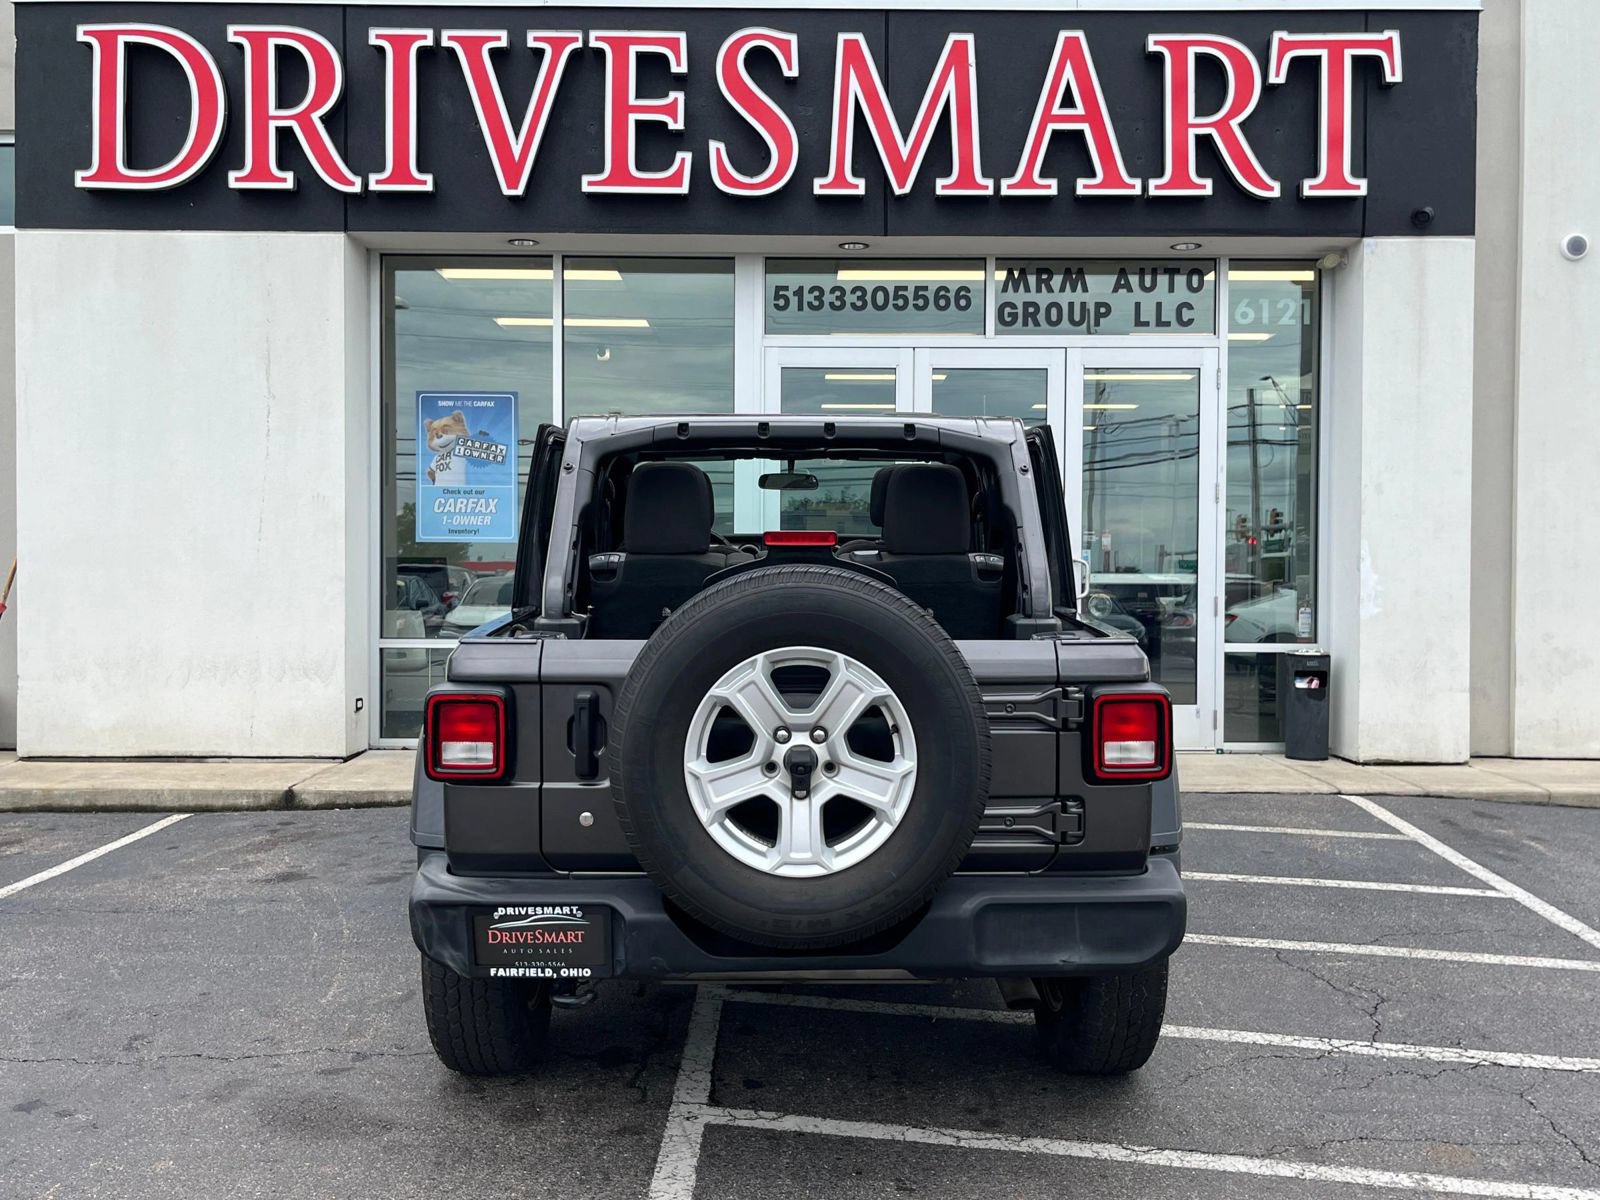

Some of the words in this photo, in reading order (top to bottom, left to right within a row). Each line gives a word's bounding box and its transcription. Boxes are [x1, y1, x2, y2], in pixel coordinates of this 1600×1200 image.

[75, 23, 1403, 199] DRIVESMART
[1001, 267, 1089, 293] MRM
[1111, 267, 1205, 293] AUTO
[773, 285, 972, 312] 5133305566
[997, 301, 1112, 328] GROUP
[1134, 301, 1195, 327] LLC
[1234, 298, 1311, 326] 6121
[458, 438, 505, 455] CARFAX
[435, 452, 452, 463] CAR
[464, 449, 503, 463] OWNER
[435, 461, 452, 472] FOX
[433, 497, 498, 513] CARFAX
[442, 515, 492, 526] 1-OWNER
[448, 528, 480, 536] Inventory!
[497, 906, 579, 915] DRIVESMART
[489, 968, 557, 979] FAIRFIELD,
[560, 968, 592, 977] OHIO
